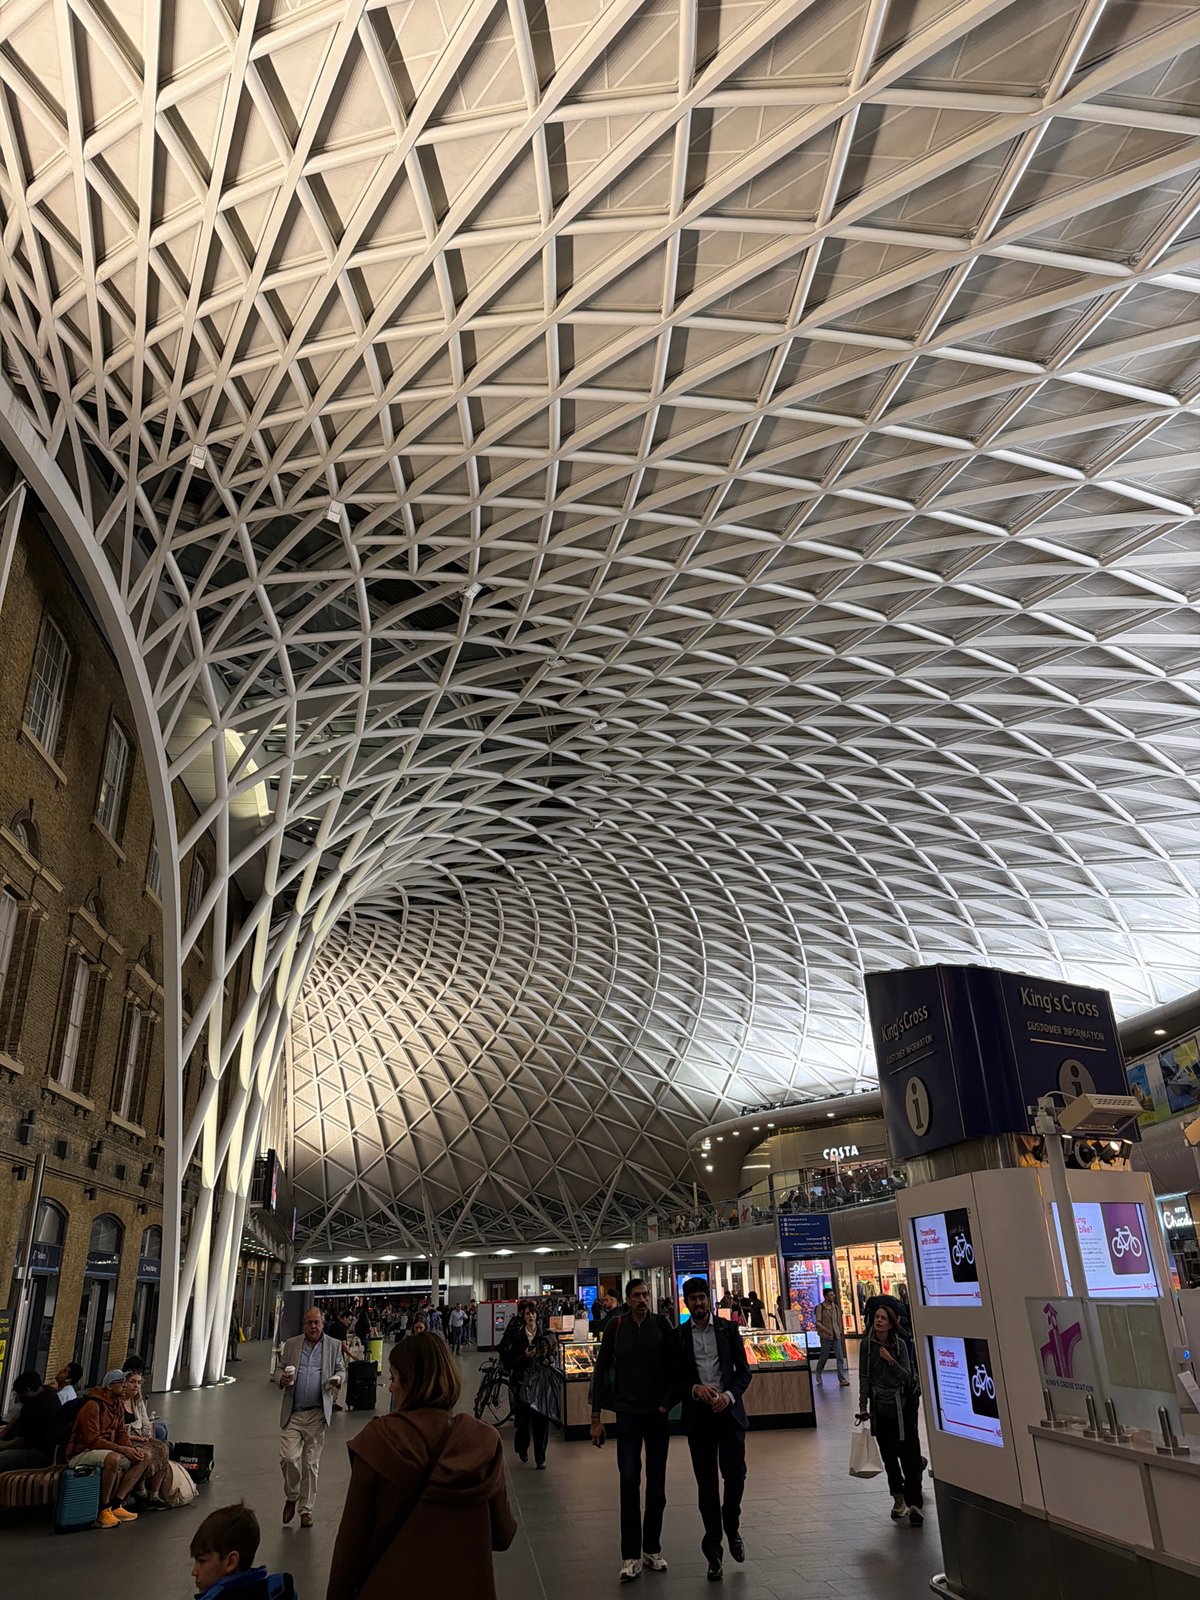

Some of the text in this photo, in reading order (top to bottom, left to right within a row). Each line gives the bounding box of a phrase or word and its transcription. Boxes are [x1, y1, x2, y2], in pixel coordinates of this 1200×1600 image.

[1019, 985, 1099, 1017] King's Cross
[881, 1005, 928, 1043] King's Cross
[1027, 1021, 1105, 1041] CUSTOMER INFORMATION
[823, 1145, 859, 1160] COSTA
[1079, 1225, 1093, 1234] bike?
